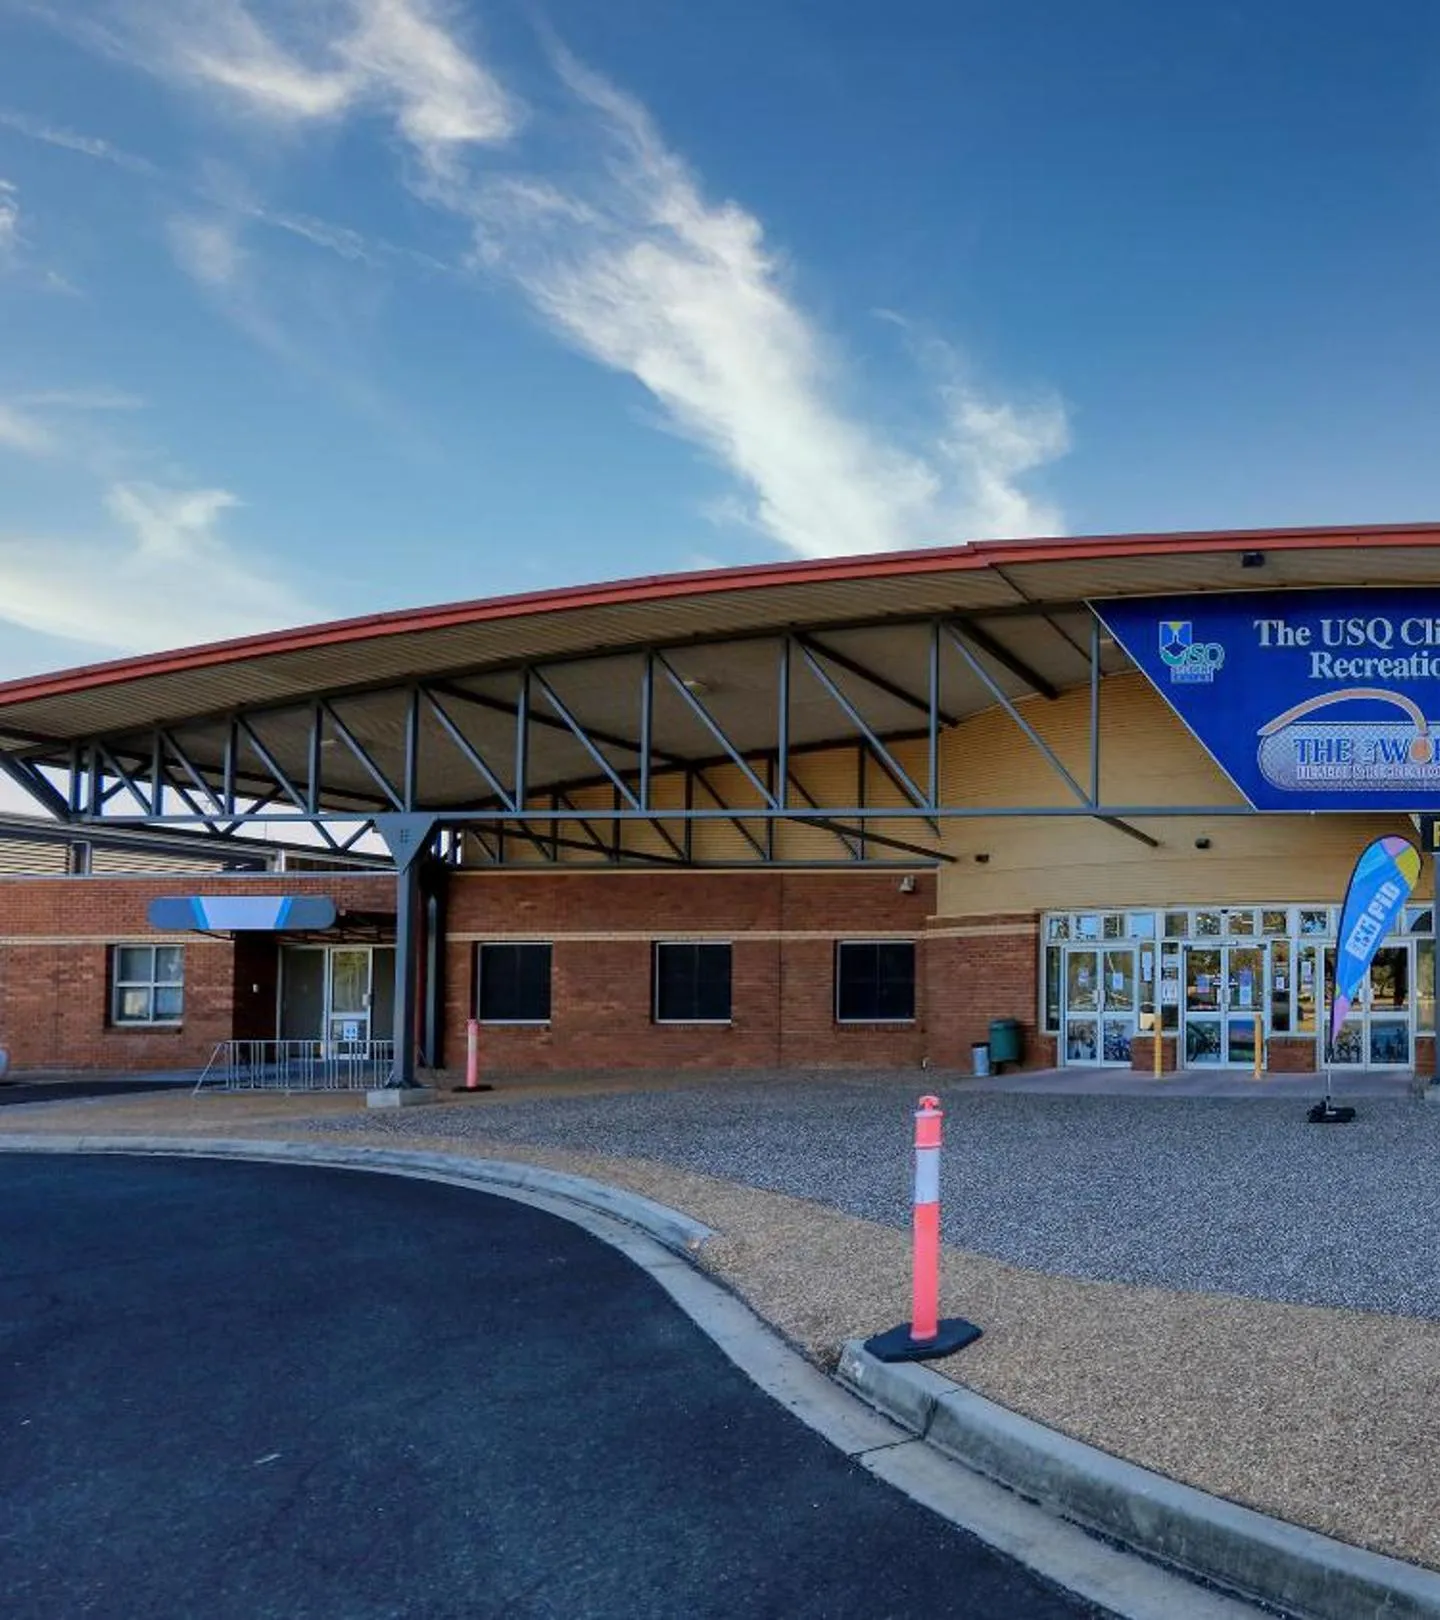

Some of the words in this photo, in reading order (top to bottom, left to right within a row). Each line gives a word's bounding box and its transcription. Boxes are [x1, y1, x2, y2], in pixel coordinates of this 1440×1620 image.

[1253, 618, 1312, 647] The
[1320, 617, 1394, 650] USQ
[1294, 738, 1352, 765] THE
